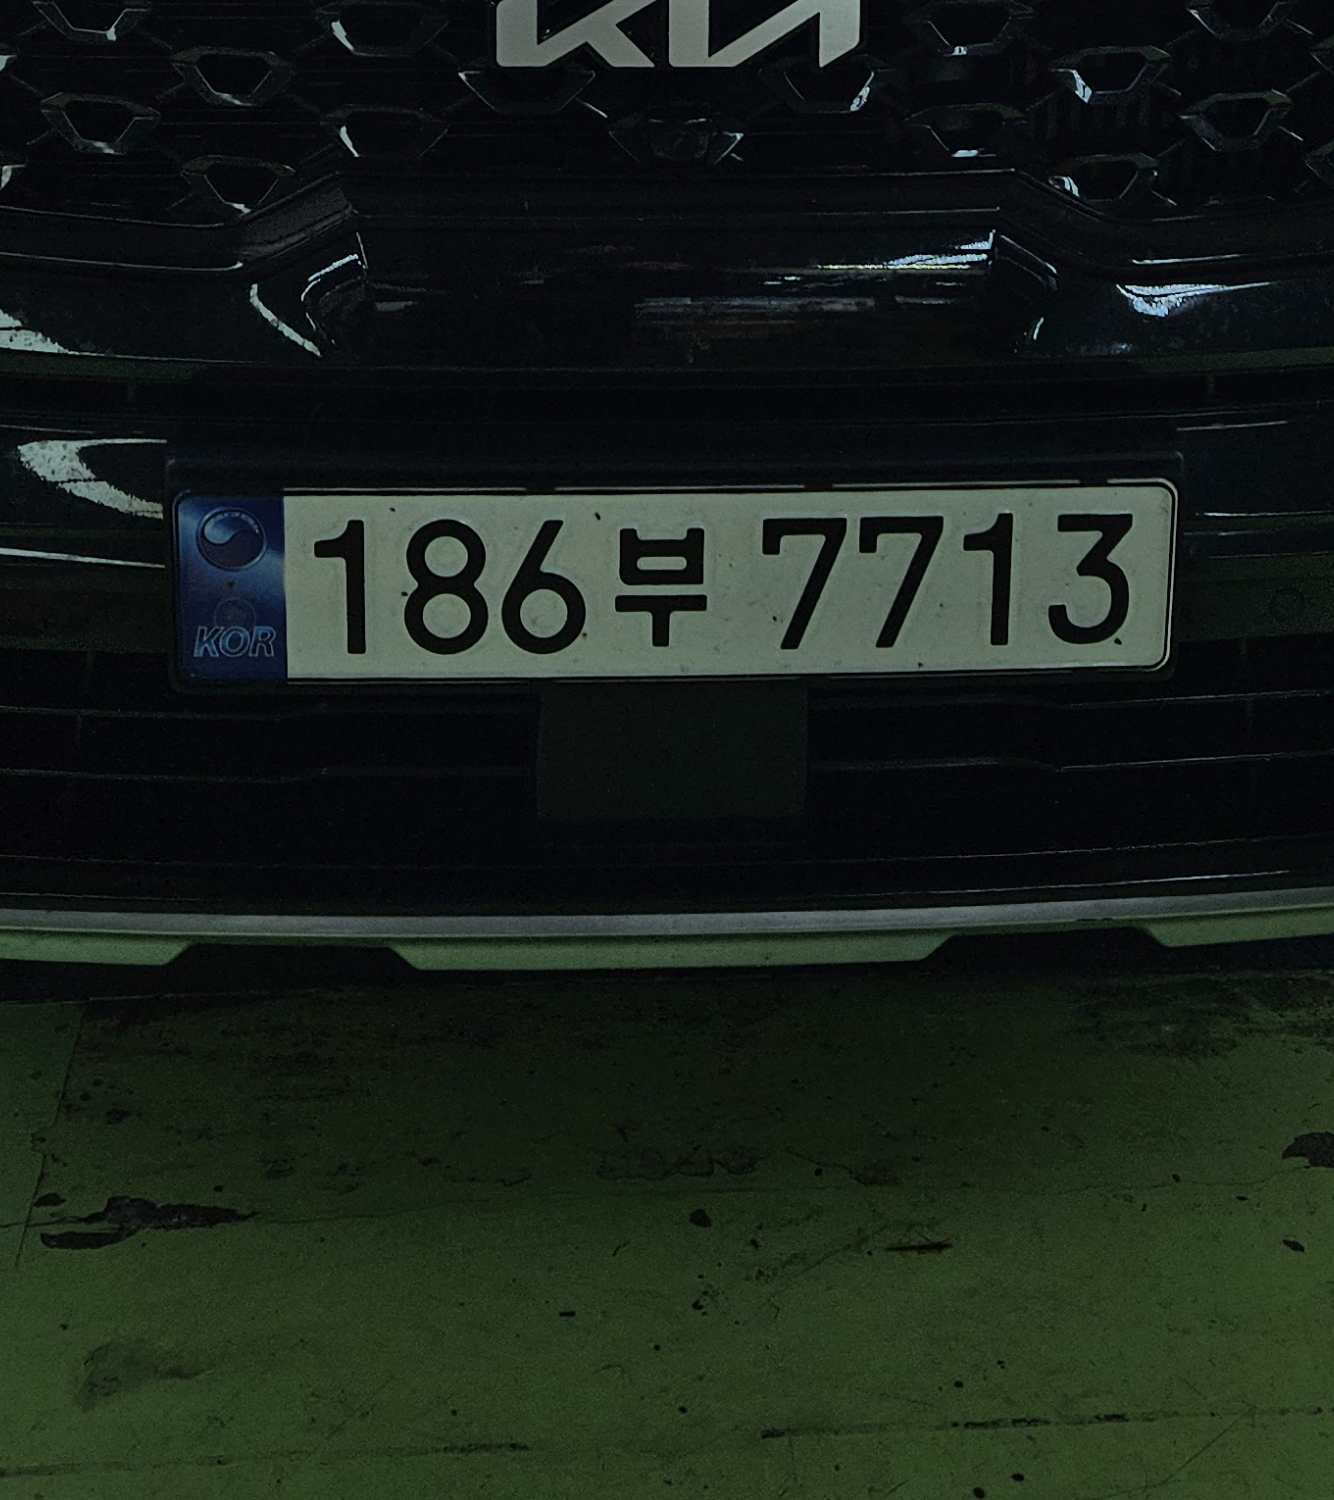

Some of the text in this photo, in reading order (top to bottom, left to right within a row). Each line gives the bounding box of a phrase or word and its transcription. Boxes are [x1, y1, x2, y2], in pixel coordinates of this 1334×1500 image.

[312, 513, 1135, 654] 186부 7713
[193, 625, 277, 658] KOR
